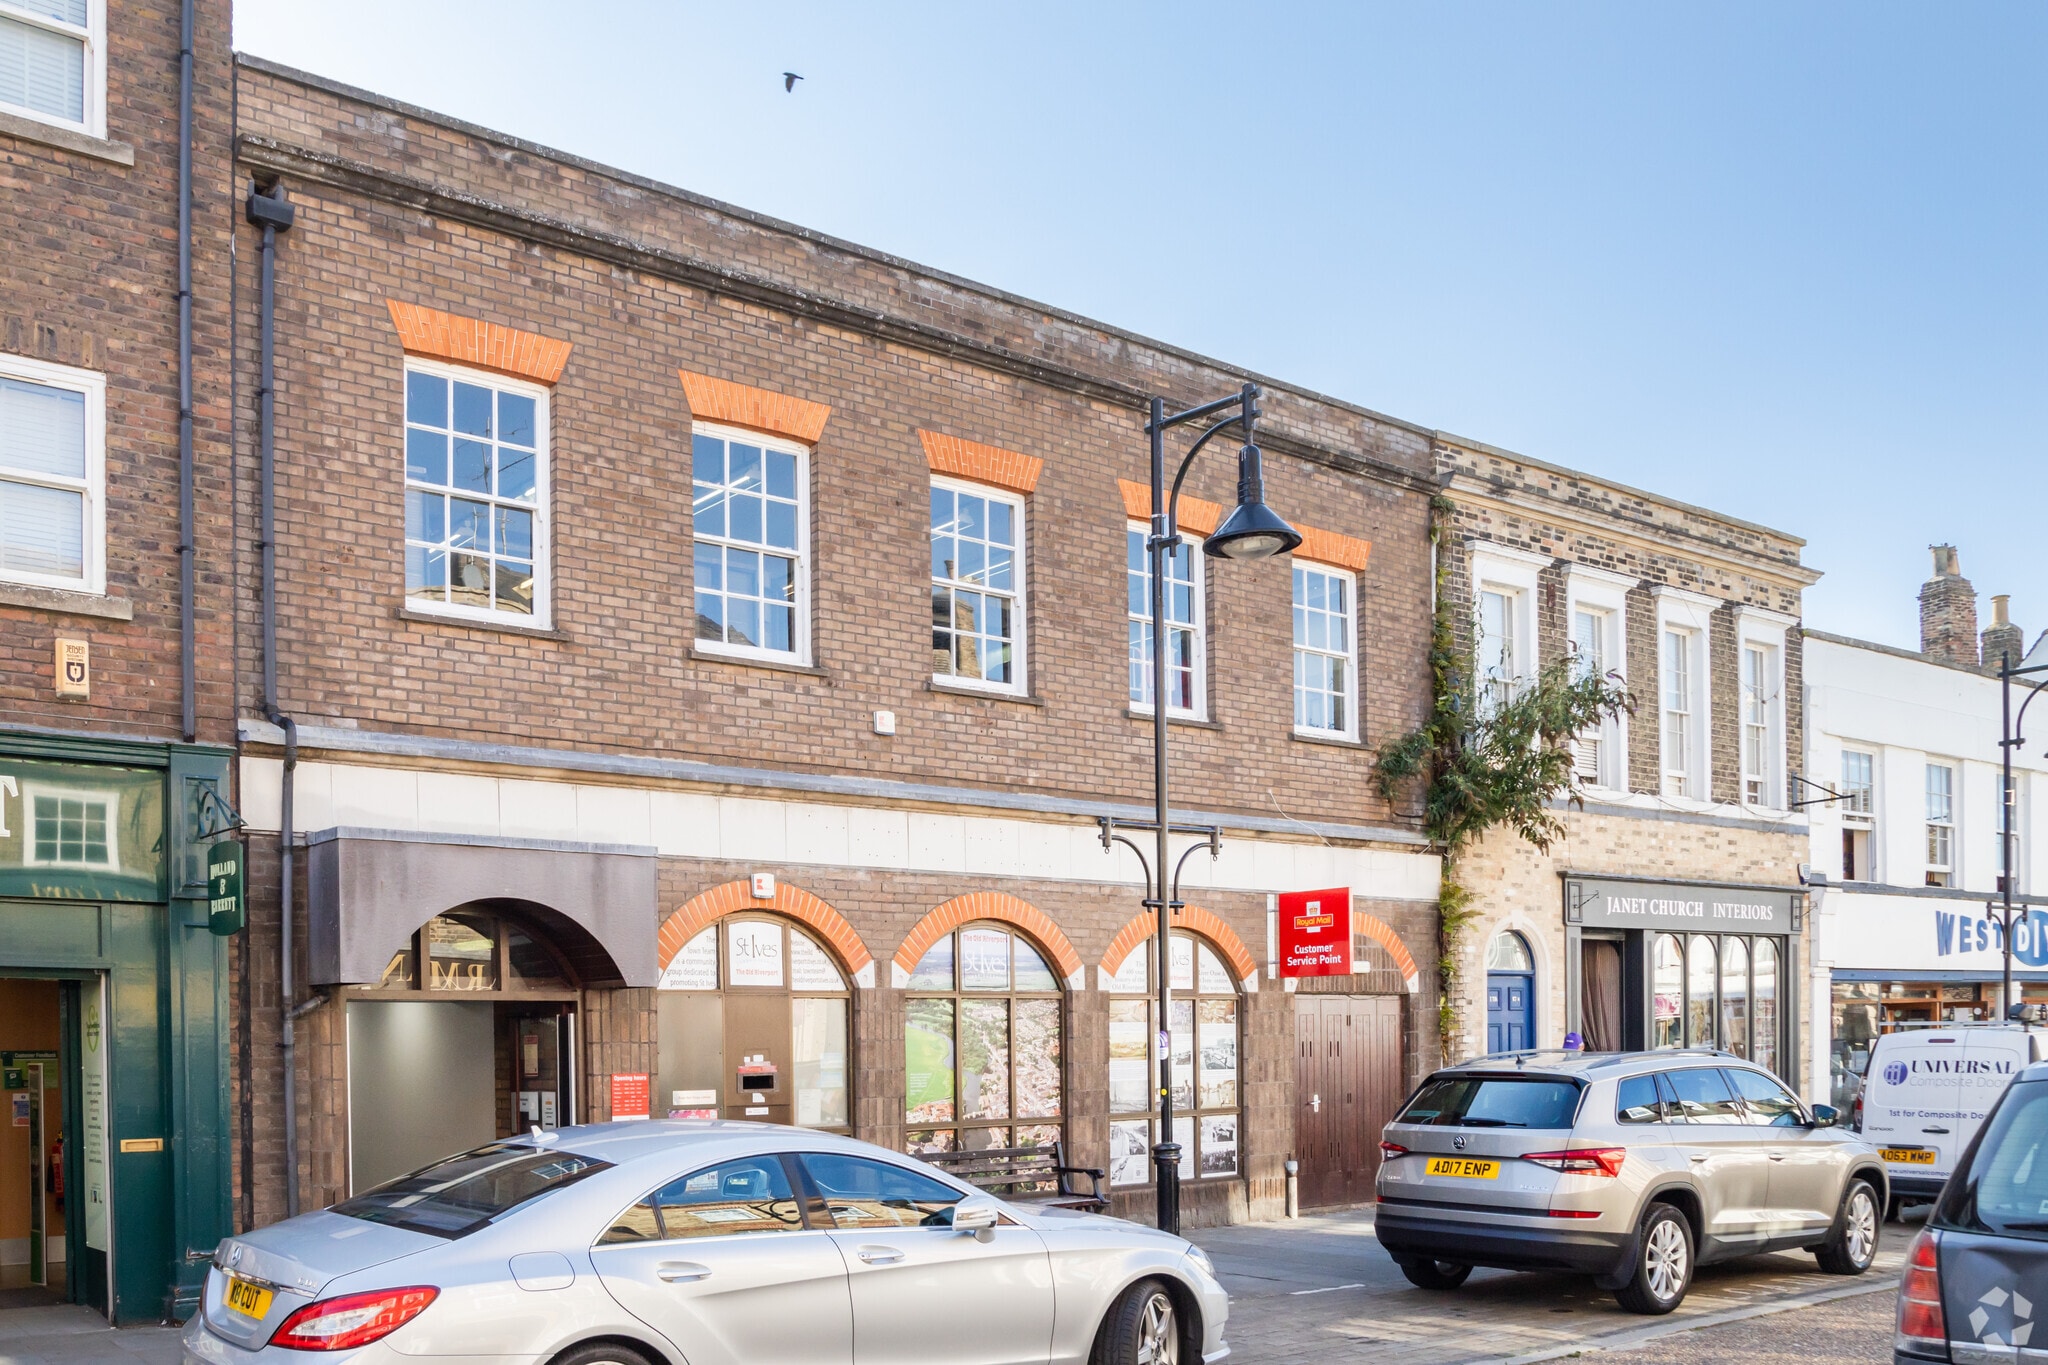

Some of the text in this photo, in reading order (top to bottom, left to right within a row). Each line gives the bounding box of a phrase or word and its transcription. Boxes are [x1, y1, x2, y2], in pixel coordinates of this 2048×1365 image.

[66, 644, 85, 654] JENSEN
[210, 860, 236, 880] HOLLAND
[211, 896, 236, 916] BARRETT
[1607, 896, 1773, 920] JANET CHURCH INTERIORS
[1296, 915, 1331, 926] Royal Mail
[1936, 910, 2002, 956] WEST
[736, 934, 778, 958] St Ives
[1294, 944, 1333, 954] Customer
[1287, 954, 1342, 966] Service Point
[736, 968, 745, 976] The
[746, 968, 754, 976] Old
[1911, 1060, 2015, 1075] UNIVERSAL
[1909, 1076, 1973, 1088] Composite
[1889, 1109, 1900, 1117] 1st
[1903, 1109, 1915, 1117] for
[1918, 1110, 1967, 1119] Composite
[1433, 1161, 1491, 1176] AD17 ENP
[241, 1285, 261, 1311] CUT
